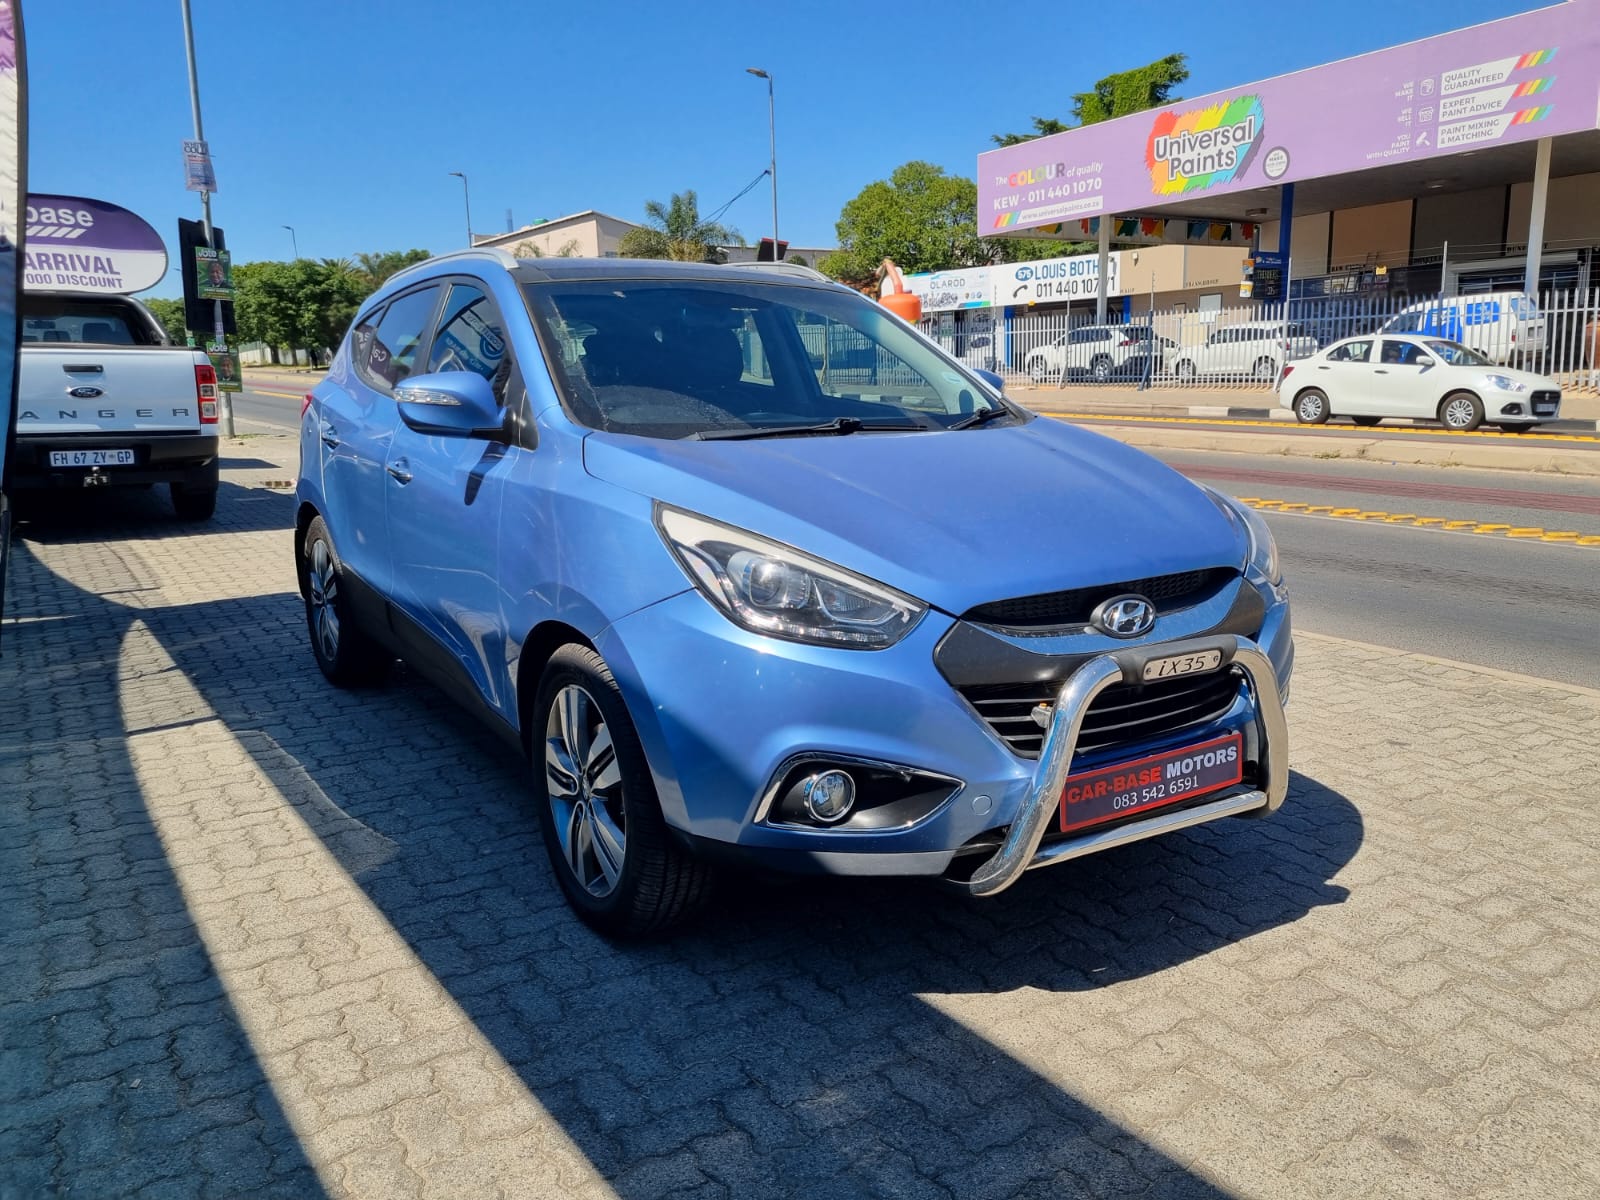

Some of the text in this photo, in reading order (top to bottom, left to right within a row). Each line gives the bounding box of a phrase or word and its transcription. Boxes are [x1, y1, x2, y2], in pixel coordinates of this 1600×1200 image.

[1444, 68, 1481, 83] QUALITY
[1444, 72, 1504, 91] GUARANTEED
[1442, 96, 1476, 109] EXPERT
[1442, 100, 1502, 118] PAINT ADVICE
[1441, 119, 1500, 136] PAINT MIXING
[1447, 129, 1493, 143] MATCHING
[1155, 117, 1254, 160] Universal
[1169, 148, 1236, 179] Paints
[995, 161, 1103, 188] The COLOUR of quality
[993, 194, 1020, 211] KEW
[1028, 188, 1045, 203] 011
[1047, 183, 1071, 199] 440
[1073, 177, 1102, 195] 1070
[25, 252, 121, 275] ARRIVAL
[1035, 262, 1066, 280] LOUIS
[1069, 259, 1100, 277] BOTH
[56, 274, 123, 289] DISCOUNT
[1036, 282, 1052, 298] 011
[1056, 280, 1078, 296] 440
[19, 408, 189, 420] ANGER
[53, 451, 131, 465] FH 67 ZY GP
[1067, 745, 1237, 804] CAR-BASE MOTORS
[1113, 775, 1199, 810] 083 542 6591
